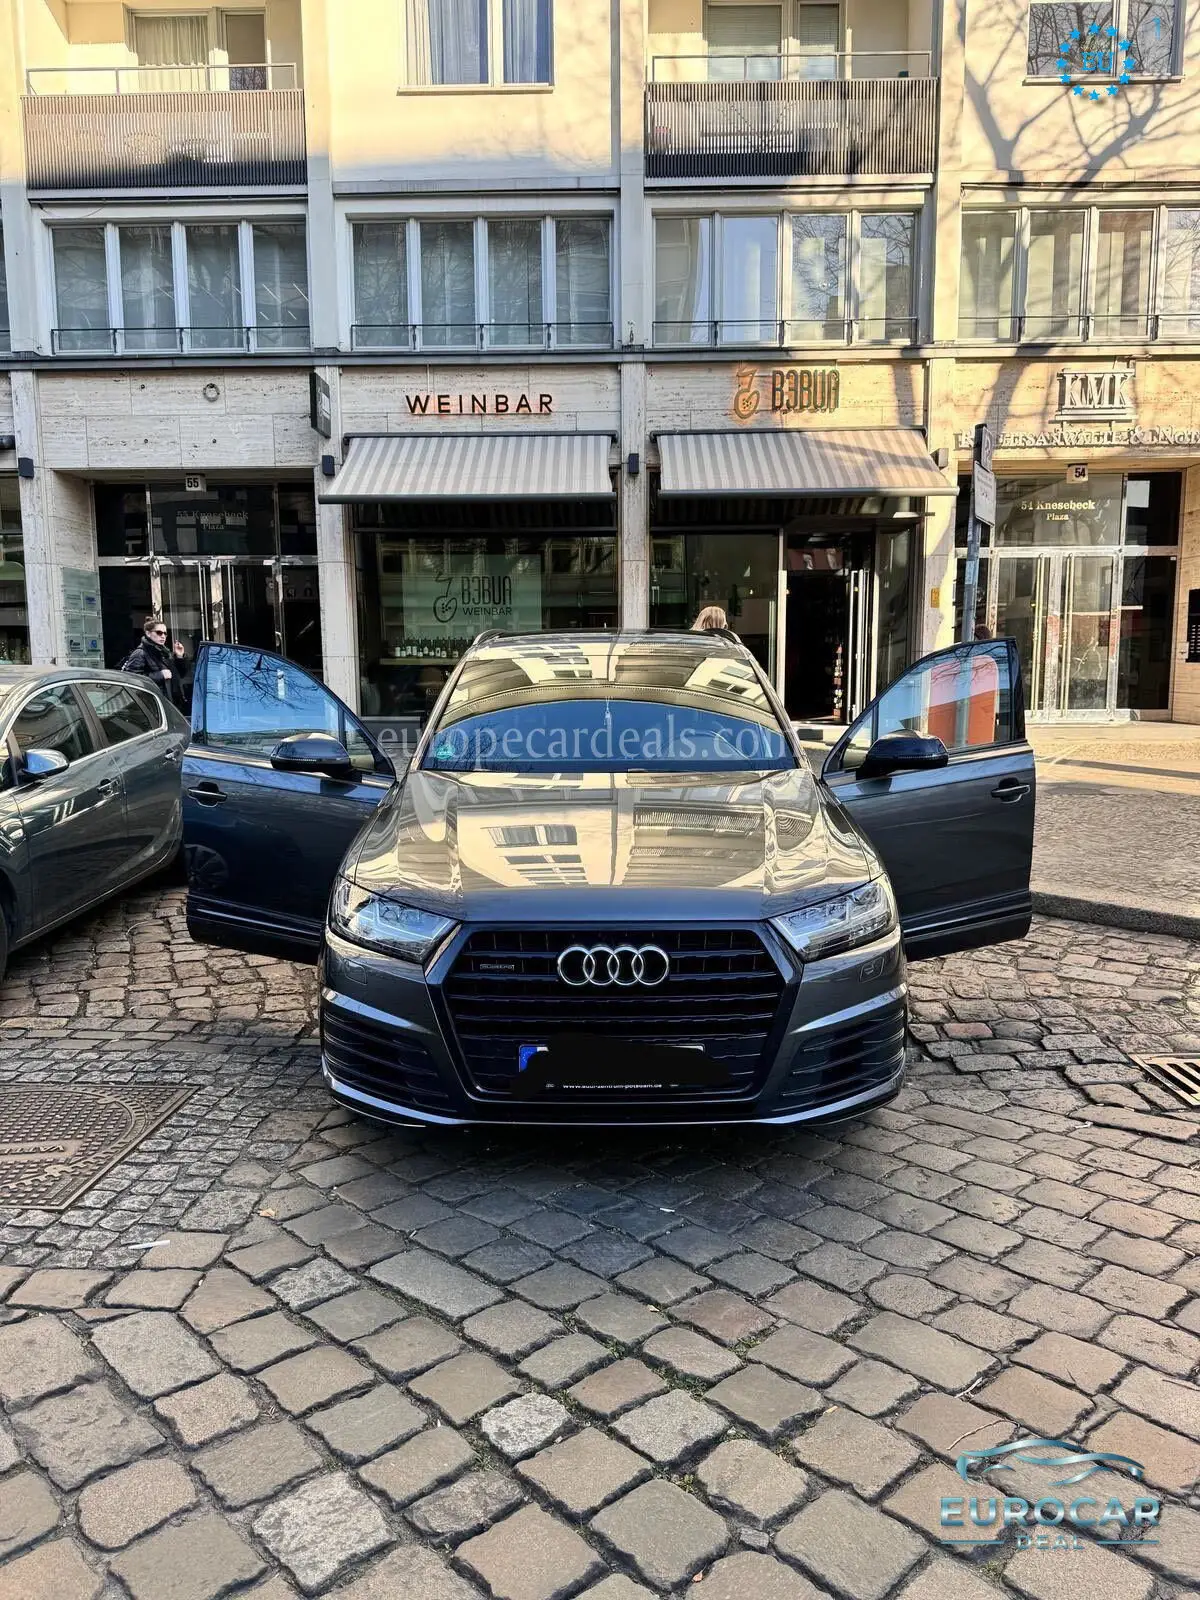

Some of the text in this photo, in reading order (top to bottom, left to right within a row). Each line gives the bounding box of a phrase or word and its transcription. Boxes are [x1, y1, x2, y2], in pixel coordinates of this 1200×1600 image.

[1060, 373, 1133, 410] KMK
[406, 394, 553, 413] WEINBAR
[1130, 424, 1145, 446] &
[1074, 468, 1086, 478] 54
[186, 477, 199, 488] 55
[1036, 499, 1096, 511] Knesebeck
[1046, 513, 1069, 521] Plaza
[462, 606, 512, 616] WEINBAR
